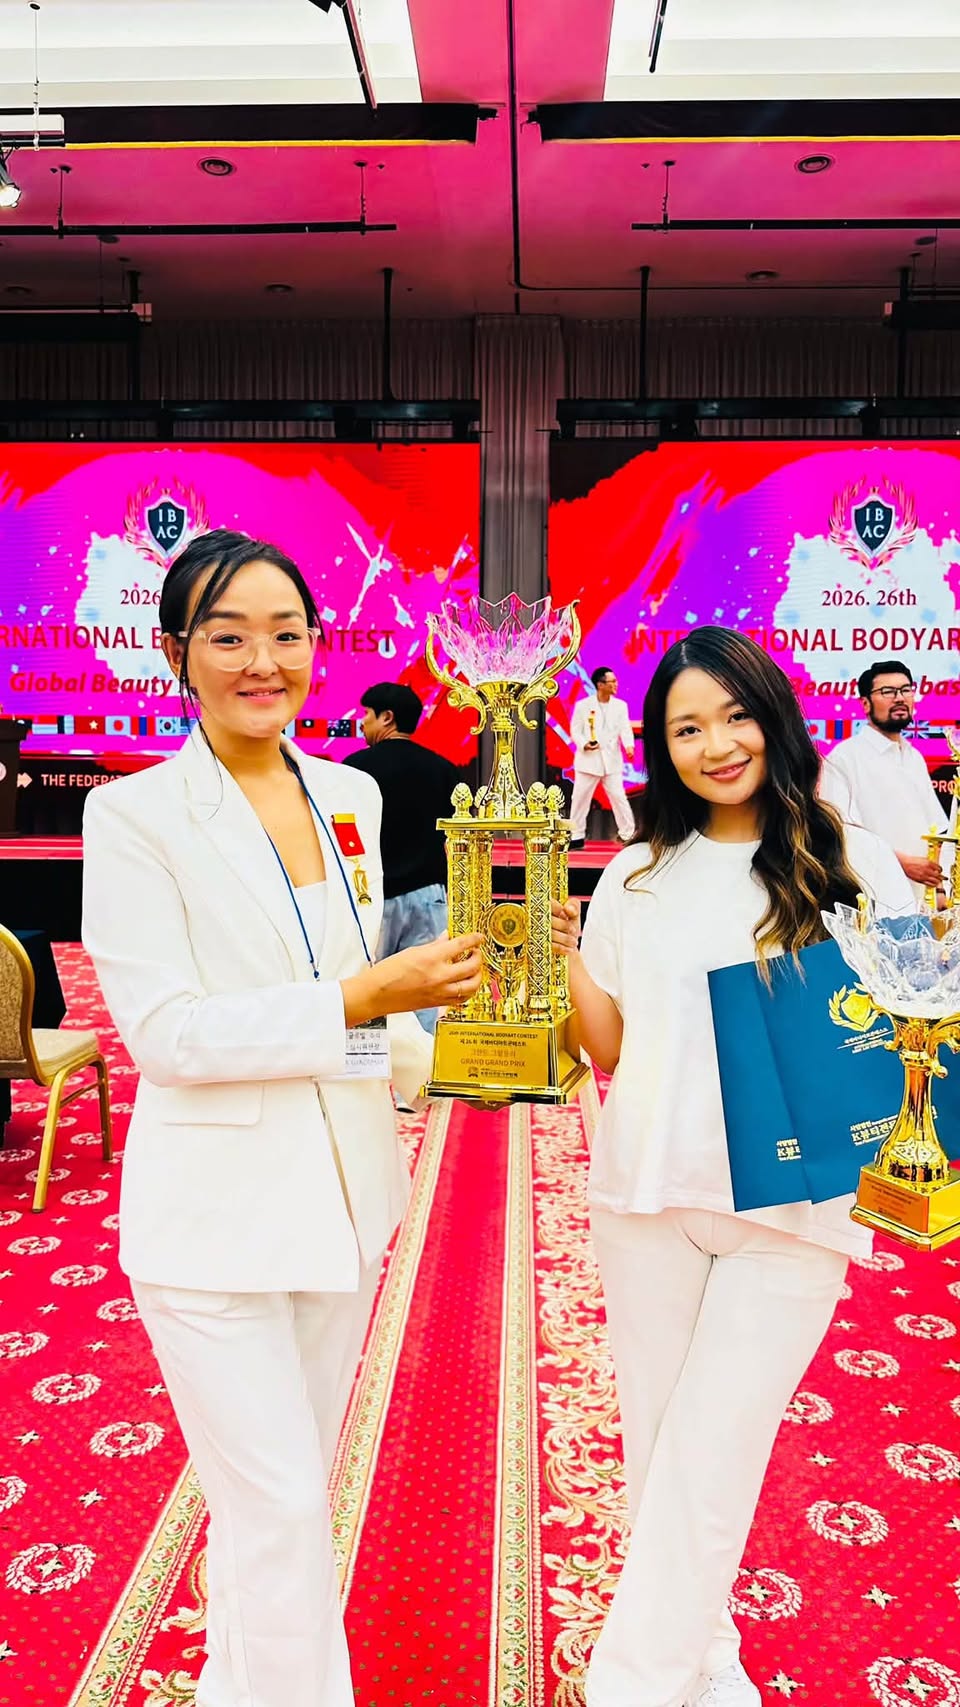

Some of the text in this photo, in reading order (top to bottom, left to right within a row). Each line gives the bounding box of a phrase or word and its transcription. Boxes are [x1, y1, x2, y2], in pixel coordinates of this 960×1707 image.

[120, 589, 161, 605] 2026
[822, 589, 917, 606] 2026. 26th
[9, 673, 173, 697] Global Beauty
[790, 678, 857, 696] eaut
[41, 774, 124, 787] THE FEDER
